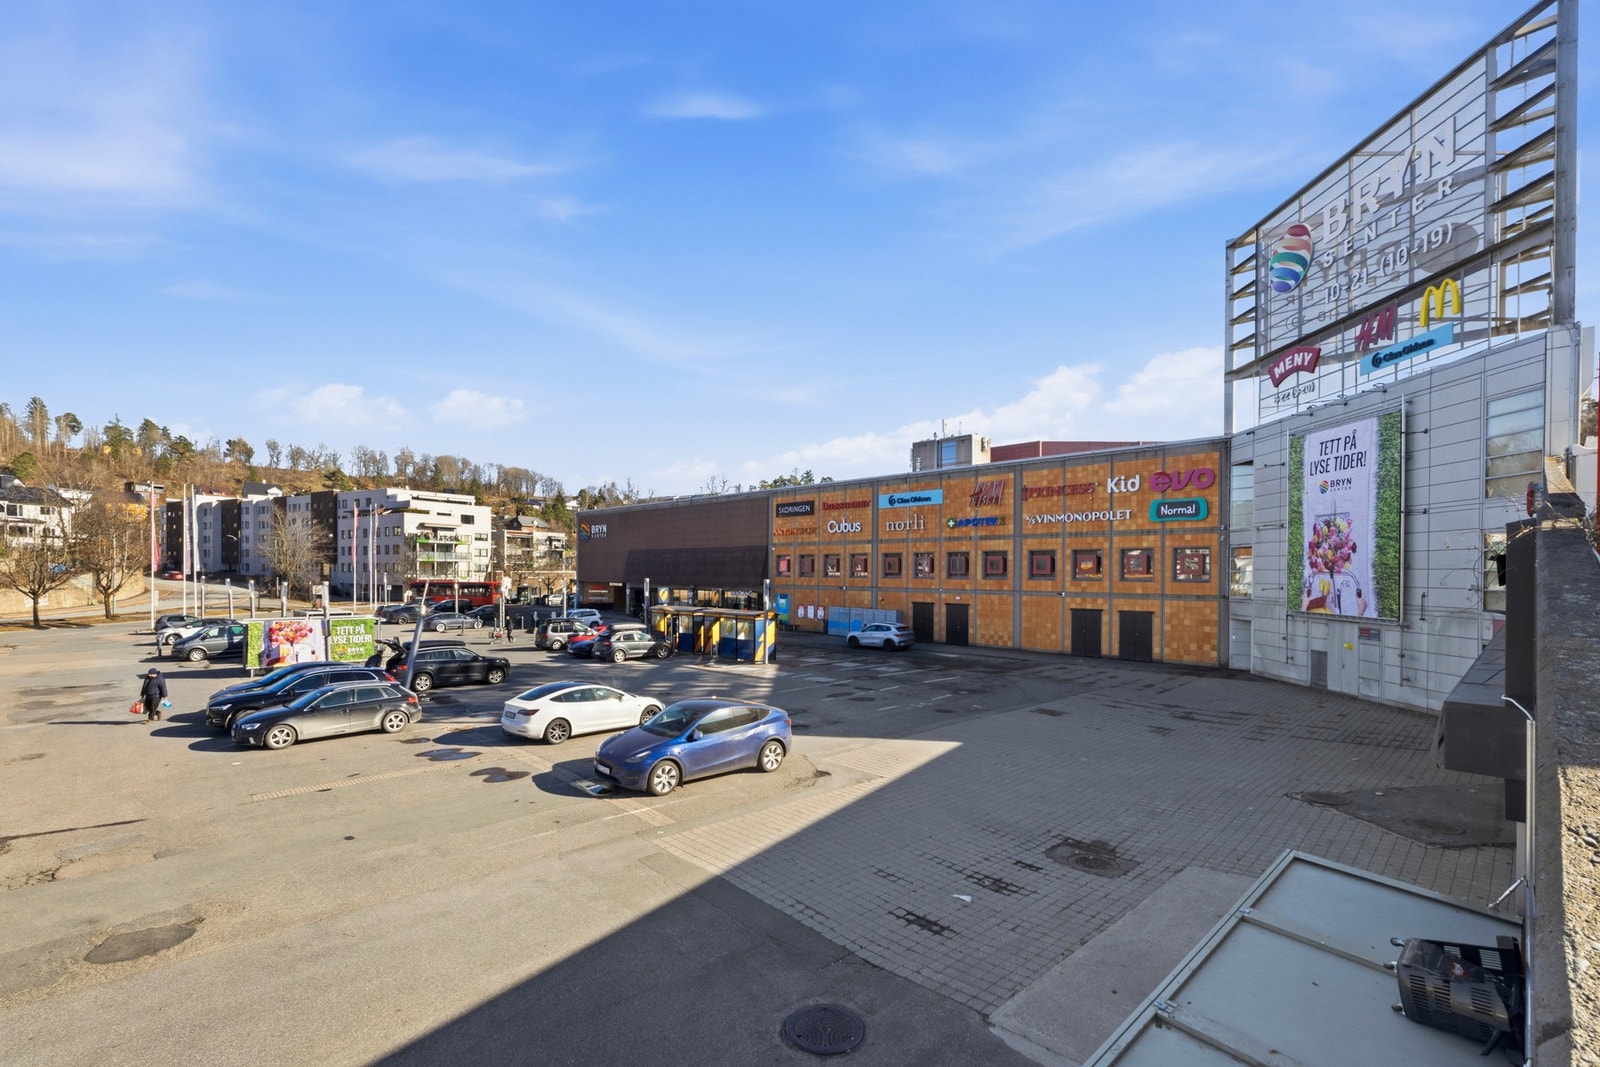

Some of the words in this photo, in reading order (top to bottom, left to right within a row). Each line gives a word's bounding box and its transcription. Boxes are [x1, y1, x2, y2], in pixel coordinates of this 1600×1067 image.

[1322, 116, 1456, 245] BRYN
[1323, 176, 1454, 268] SENTER
[1324, 267, 1369, 305] 10-21
[1379, 220, 1453, 277] (10-19)
[1355, 303, 1395, 352] H&M
[1273, 352, 1313, 379] MENY
[1319, 437, 1342, 457] TETT
[1344, 429, 1357, 451] PÅ
[1309, 457, 1330, 476] LYSE
[1333, 451, 1367, 471] TIDER!
[1107, 474, 1140, 493] Kid
[1149, 467, 1215, 492] evo
[1330, 477, 1352, 488] BRYN
[969, 480, 1005, 508] H&M
[1026, 482, 1095, 499] PRINCESS
[778, 504, 811, 514] SKORINGEN
[1036, 509, 1132, 523] VINMONOPOLET
[1160, 504, 1195, 515] Normal
[591, 524, 607, 533] BRYN
[827, 518, 862, 533] Cubus
[886, 514, 925, 531] norli
[336, 626, 354, 635] TETT
[355, 624, 365, 634] PÅ
[349, 634, 372, 643] TIDER!
